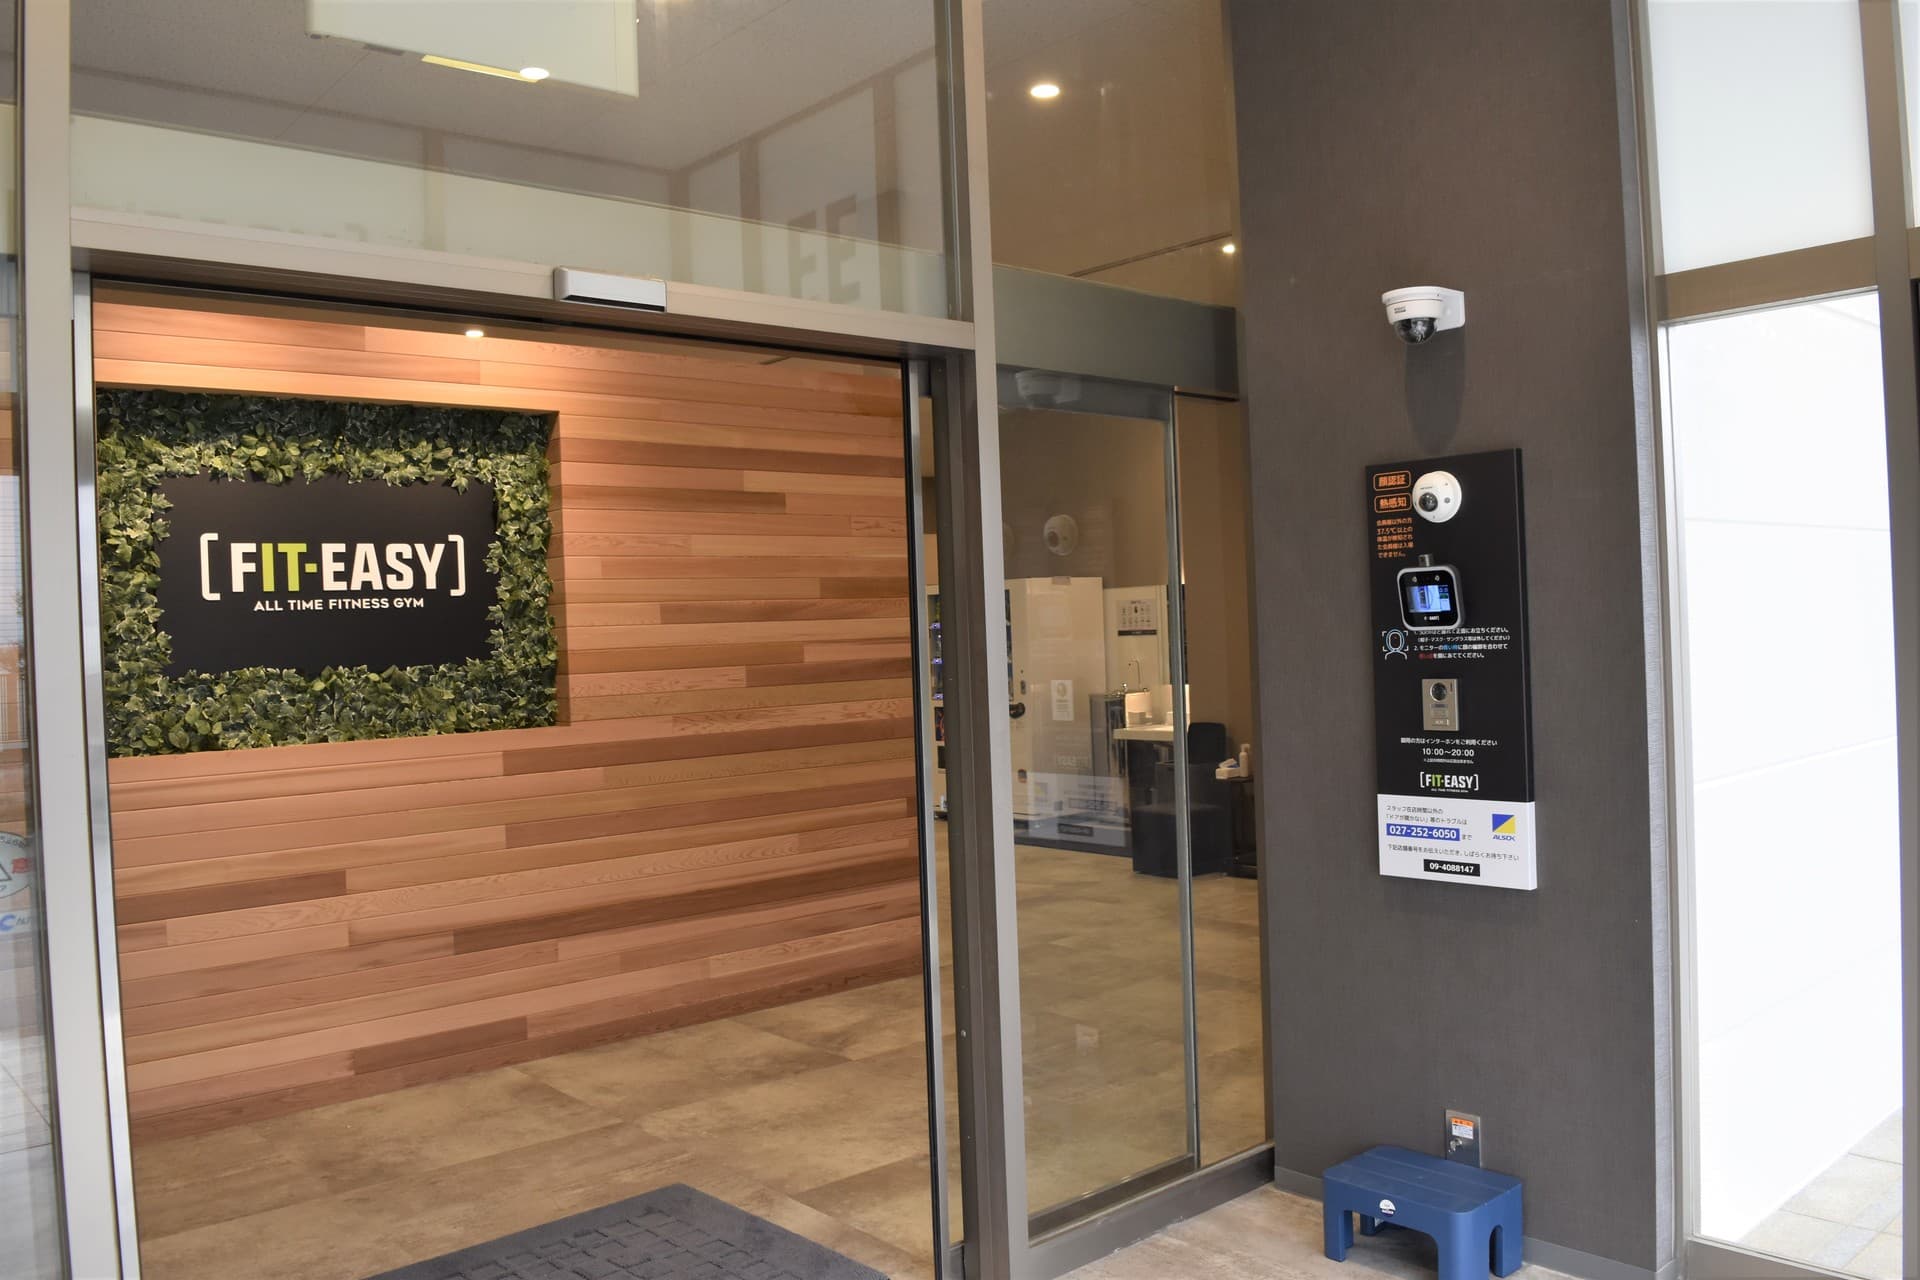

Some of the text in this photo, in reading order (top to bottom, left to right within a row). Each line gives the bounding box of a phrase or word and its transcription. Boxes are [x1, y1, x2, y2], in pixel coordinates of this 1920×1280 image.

[253, 597, 424, 612] ALL TIME FITNESS GYM
[1389, 825, 1457, 839] 027-252-6050
[1492, 834, 1516, 842] ALSOK
[1429, 862, 1474, 873] 09-4088147
